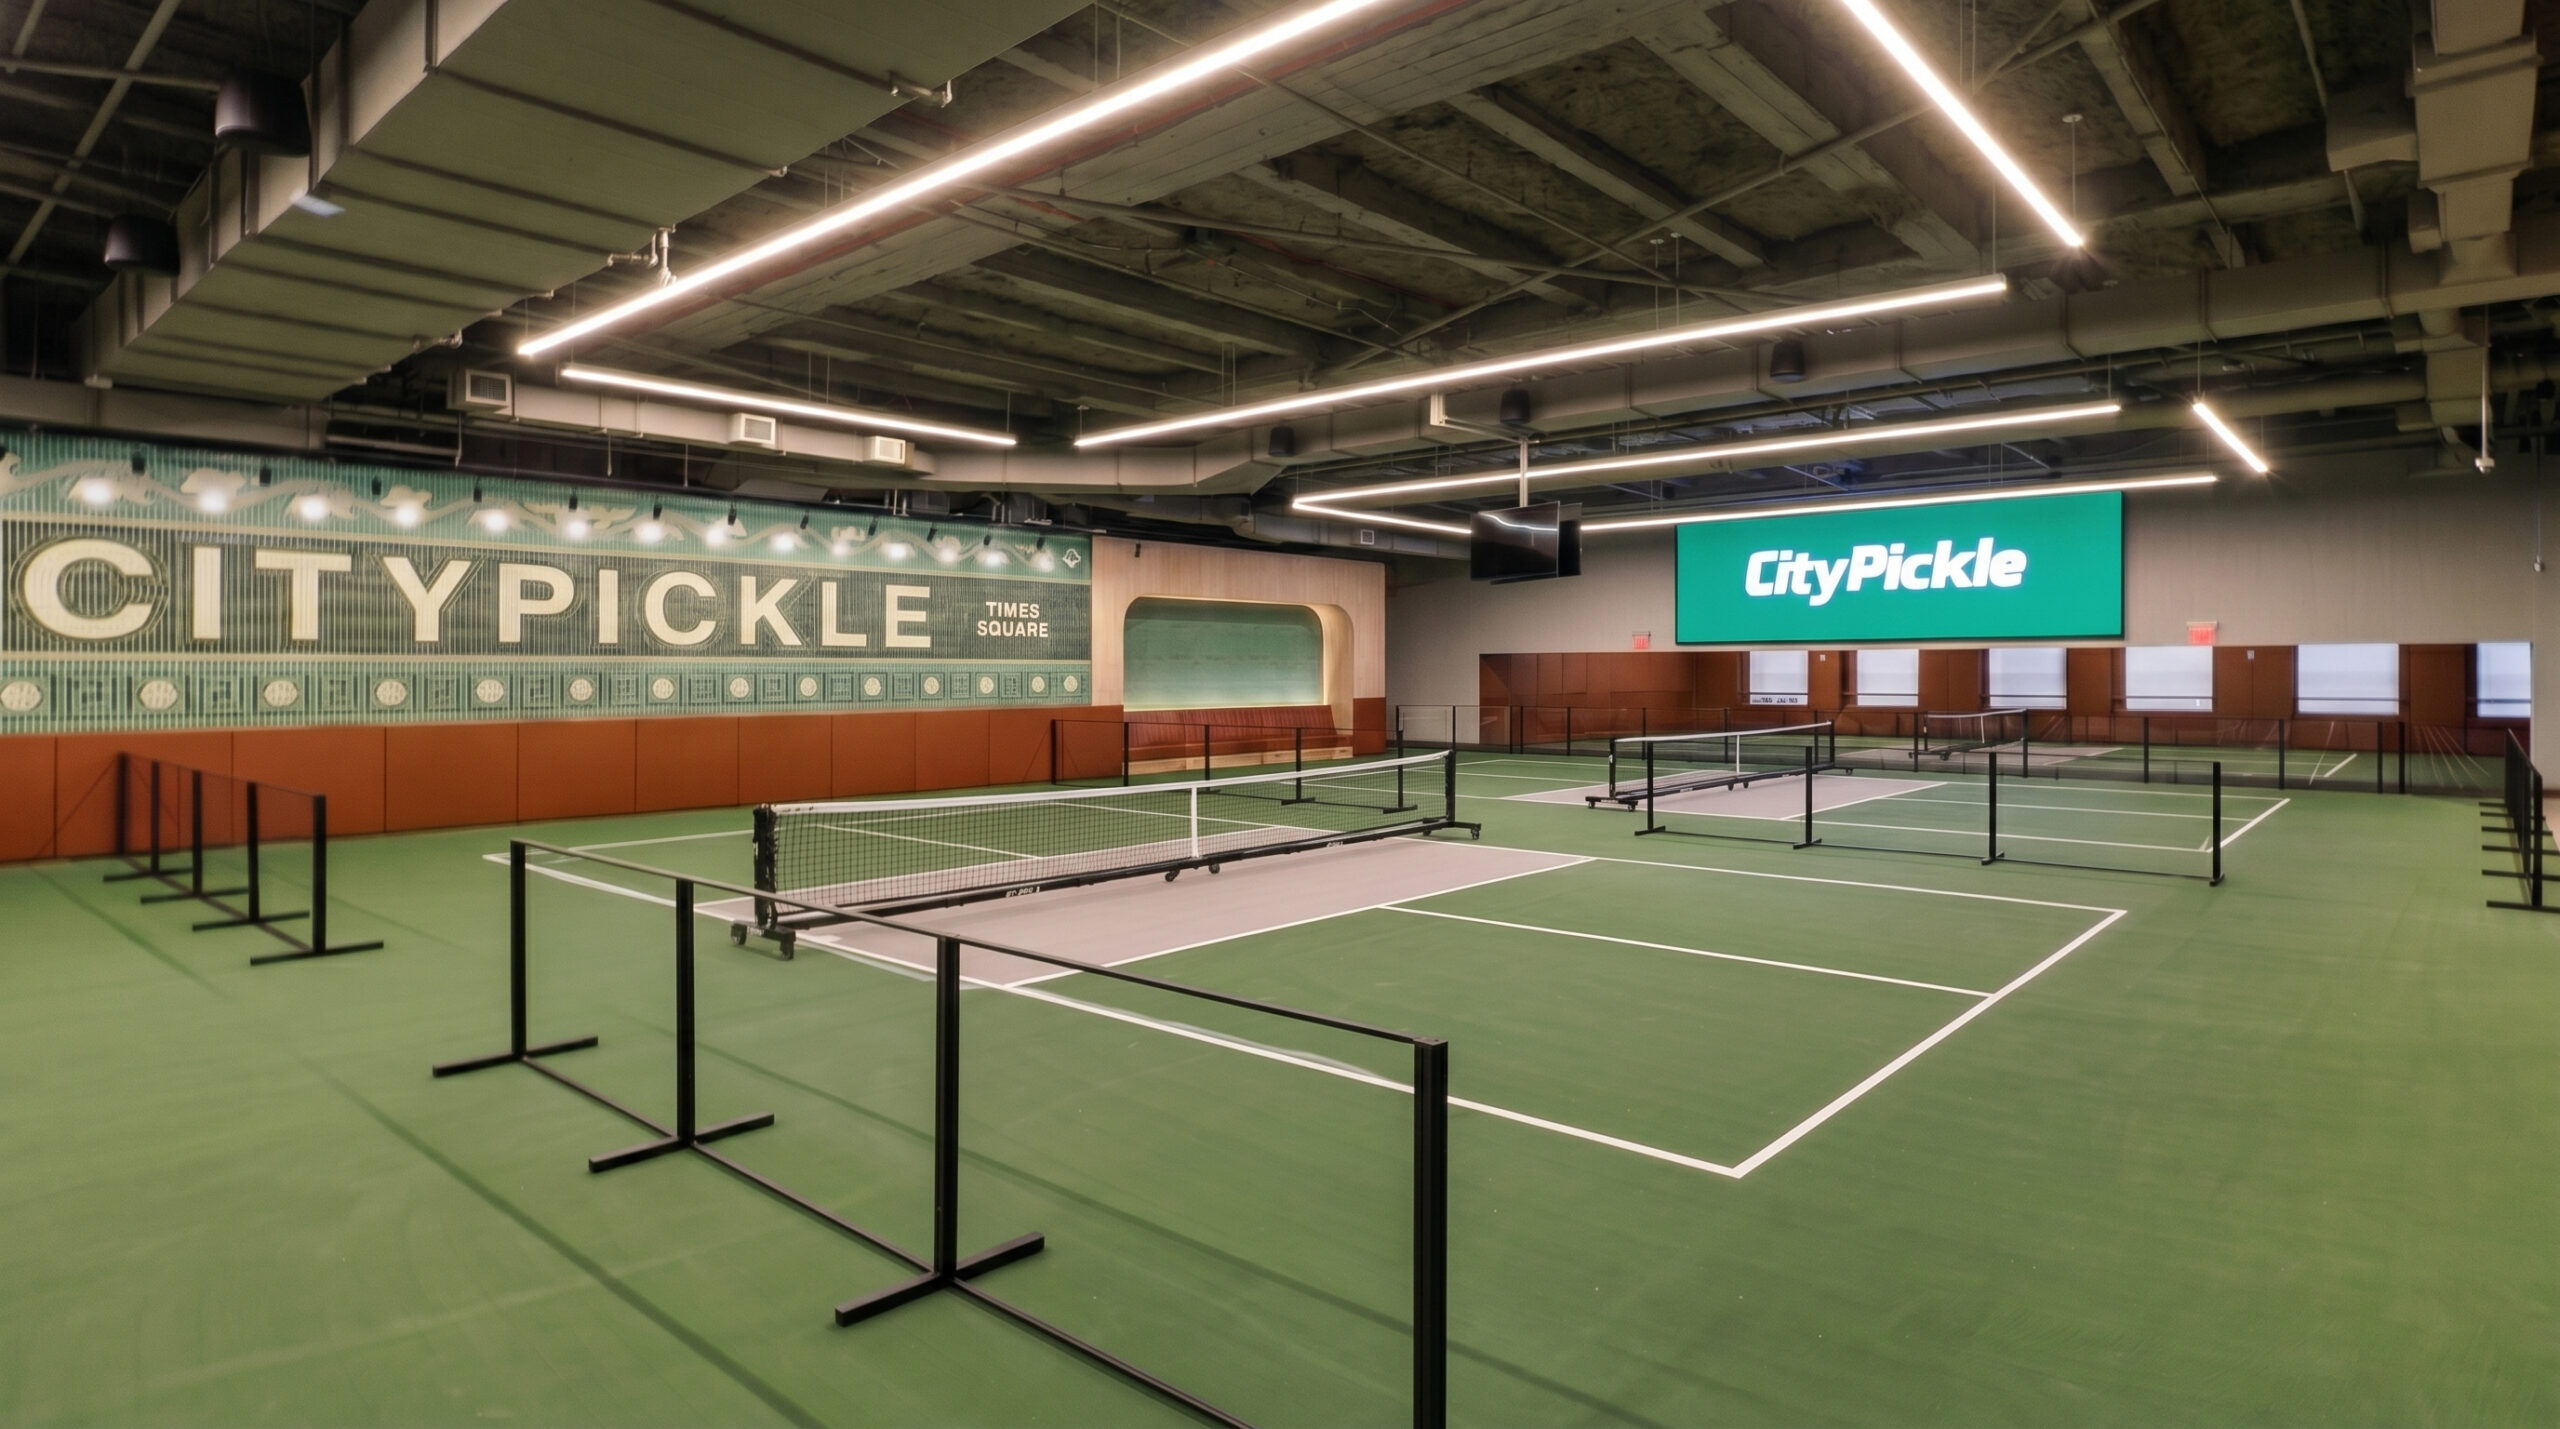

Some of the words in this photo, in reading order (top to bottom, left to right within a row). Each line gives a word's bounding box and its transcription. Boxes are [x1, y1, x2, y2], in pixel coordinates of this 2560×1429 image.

[24, 537, 931, 648] CITYPICKLE
[1745, 537, 2027, 606] CityPickle
[977, 620, 1049, 638] SQUARE
[985, 601, 1040, 619] TIMES
